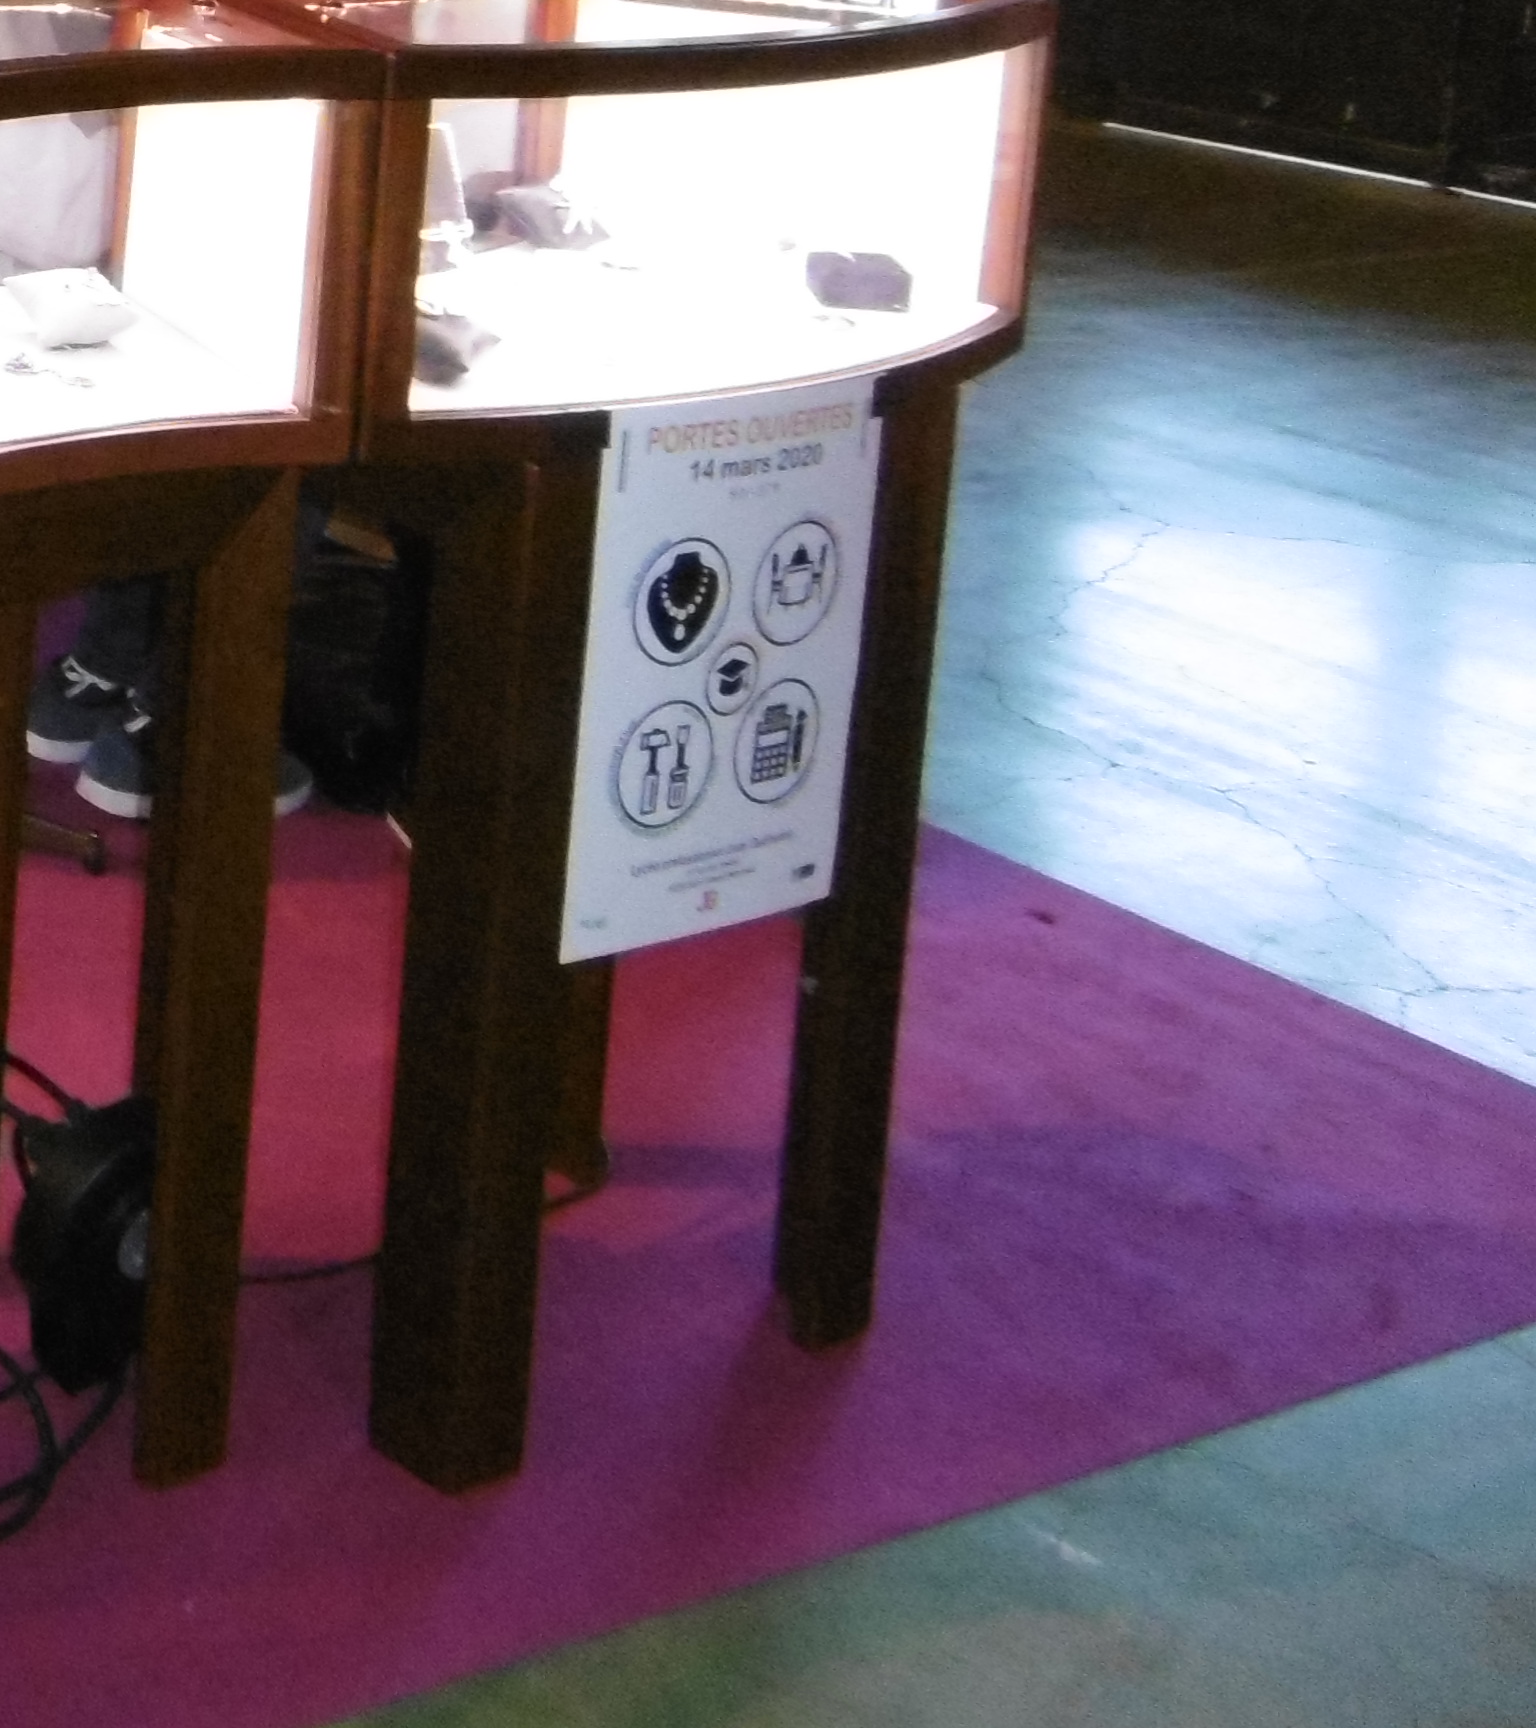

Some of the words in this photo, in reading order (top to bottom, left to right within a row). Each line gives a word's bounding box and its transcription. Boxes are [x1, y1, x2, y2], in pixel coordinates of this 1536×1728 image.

[647, 419, 739, 455] PORTES
[747, 402, 854, 445] OUVERTES
[690, 458, 715, 482] 14
[720, 456, 771, 479] mars
[776, 442, 823, 472] 2020
